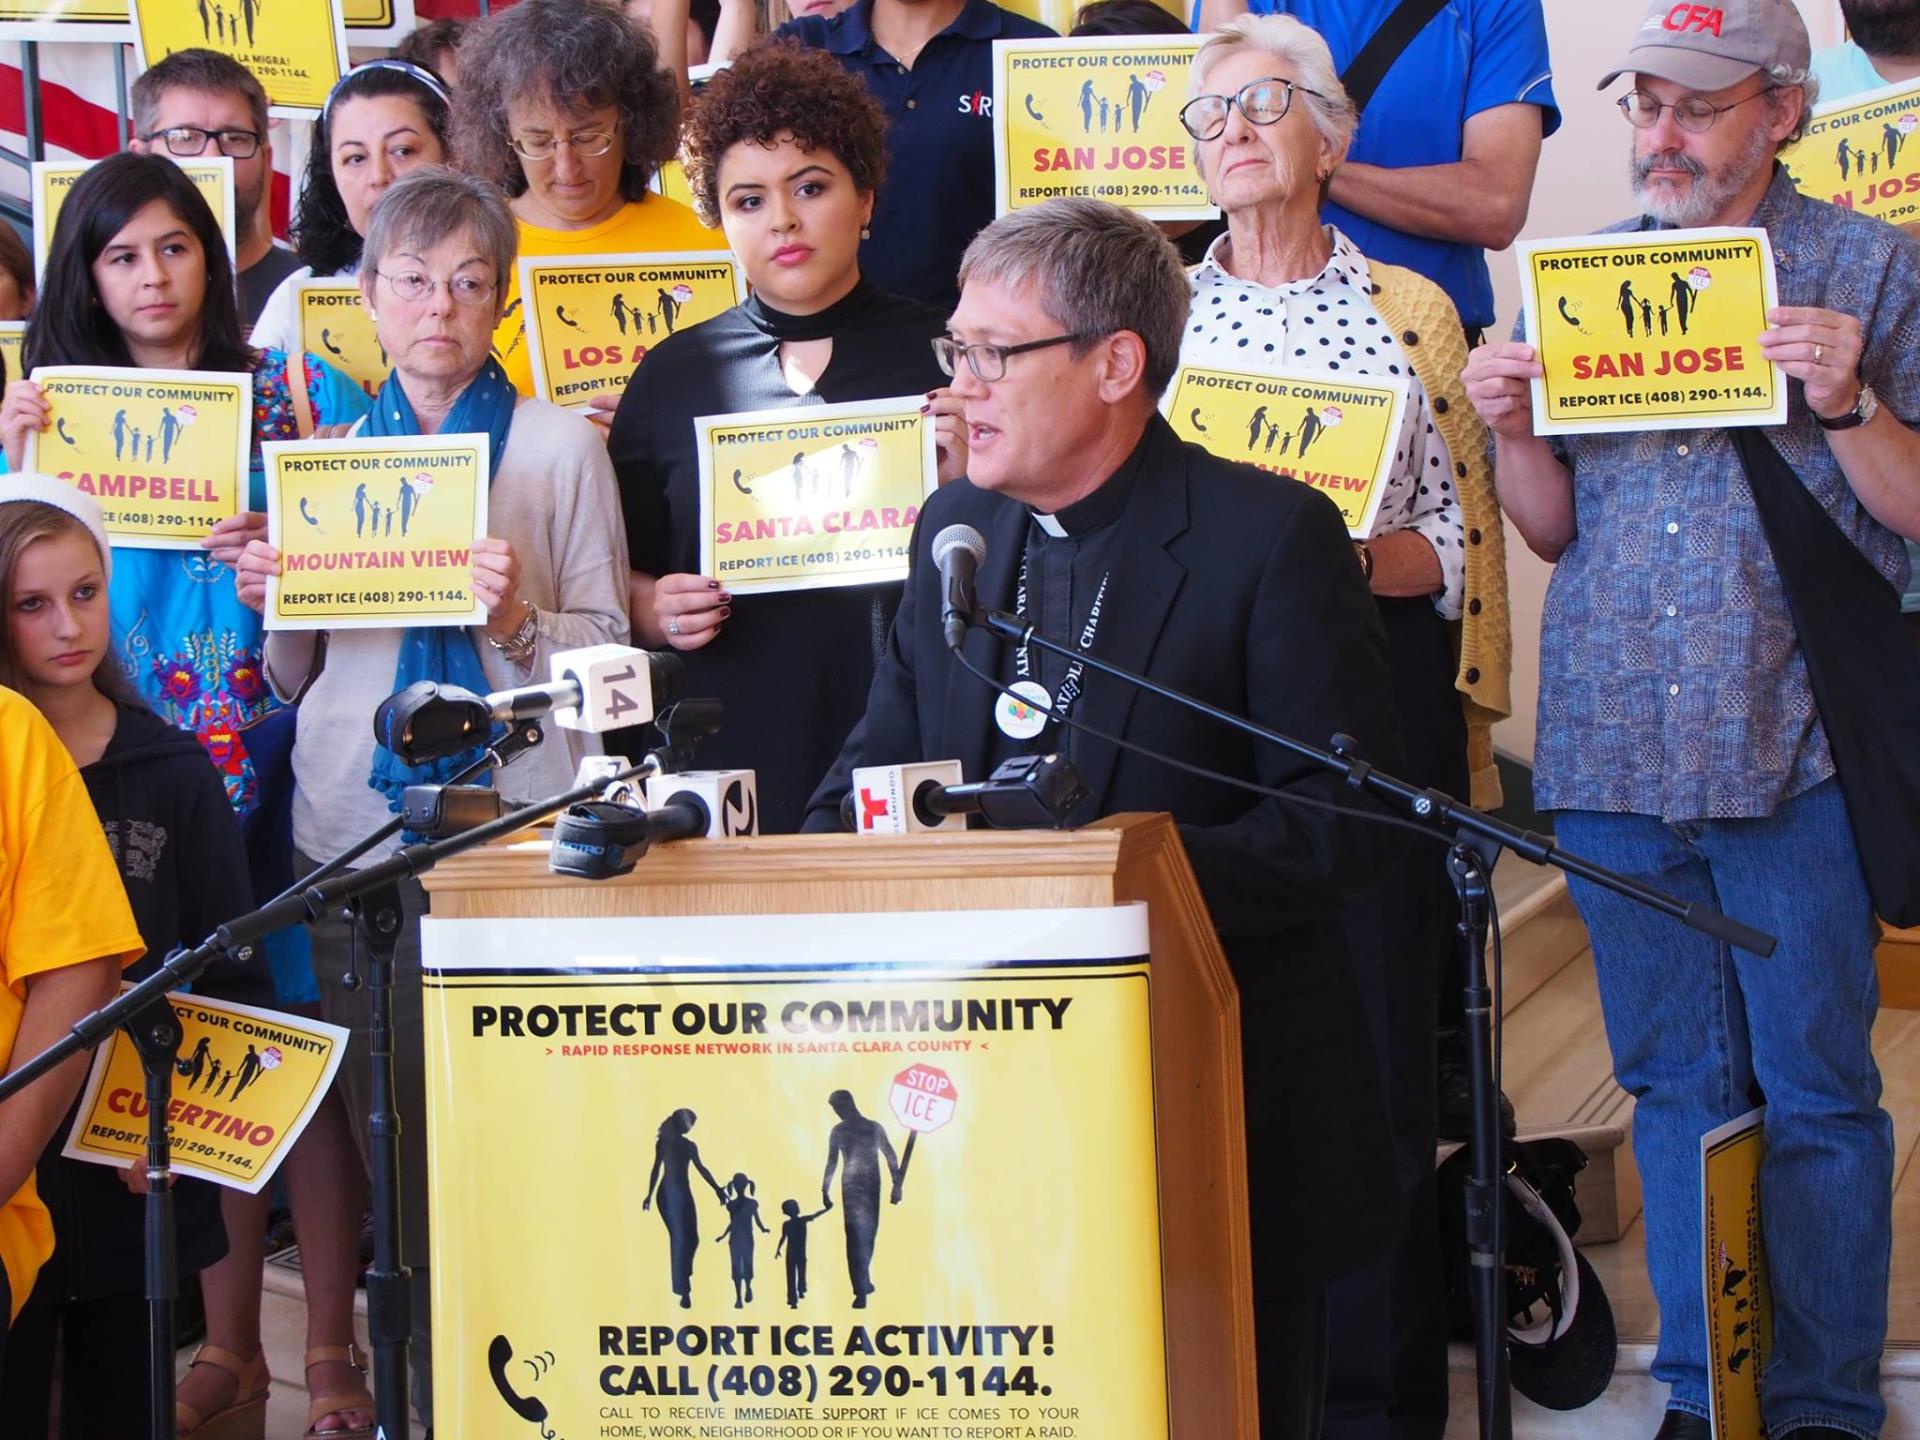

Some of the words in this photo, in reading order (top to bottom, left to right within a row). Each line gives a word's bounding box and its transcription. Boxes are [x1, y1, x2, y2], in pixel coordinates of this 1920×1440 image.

[1662, 4, 1724, 38] CFA
[238, 54, 250, 62] LA
[252, 55, 290, 66] MIGRA!
[258, 66, 310, 78] 290-1144.
[1012, 56, 1074, 70] PROTECT
[1078, 56, 1108, 67] OUR
[1112, 54, 1195, 66] COMMUNIT
[1830, 113, 1860, 130] OUR
[1864, 96, 1920, 121] COMMU
[1034, 147, 1095, 172] SAN
[1103, 146, 1185, 170] JOSE
[1020, 186, 1068, 198] REPORT
[1070, 186, 1089, 196] ICE
[1092, 184, 1128, 198] (408)
[1132, 184, 1203, 196] 290-1144.
[1862, 172, 1920, 205] JOS
[1540, 256, 1608, 270] PROTECT
[1612, 254, 1646, 266] OUR
[1650, 246, 1752, 264] COMMUNITY
[539, 273, 602, 284] PROTECT
[604, 272, 636, 283] OUR
[639, 268, 728, 281] COMMUNITY
[308, 296, 362, 306] PROTEC
[563, 345, 624, 370] LOS
[1572, 352, 1644, 380] SAN
[1654, 346, 1745, 376] JOSE
[47, 382, 108, 396] PROTECT
[112, 386, 142, 398] OUR
[146, 388, 235, 402] COMMUNITY
[556, 378, 606, 396] REPORT
[610, 375, 630, 386] ICE
[1186, 374, 1252, 392] PROTECT
[1255, 383, 1288, 396] OUR
[1292, 386, 1388, 408] COMMUNITY
[1560, 395, 1618, 408] REPORT
[1620, 393, 1642, 404] ICE
[1646, 390, 1685, 406] (408)
[1689, 386, 1767, 401] 290-1144.
[718, 430, 784, 446] PROTECT
[788, 428, 820, 440] OUR
[824, 418, 918, 436] COMMUNITY
[284, 460, 346, 472] PROTECT
[350, 458, 380, 470] OUR
[384, 456, 472, 469] COMMUNITY
[1304, 470, 1368, 492] VIEW
[118, 510, 154, 526] (408)
[716, 516, 814, 544] SANTA
[822, 506, 918, 533] CLARA
[286, 550, 405, 572] MOUNTAIN
[411, 548, 470, 568] VIEW
[719, 556, 772, 571] REPORT
[776, 555, 798, 566] ICE
[802, 551, 840, 566] (408)
[283, 592, 335, 604] REPORT
[336, 592, 356, 604] ICE
[359, 591, 394, 604] (408)
[398, 590, 468, 602] 290-1144.
[601, 664, 639, 720] 14
[472, 1003, 662, 1037] PROTECT
[672, 1002, 769, 1036] OUR
[780, 997, 1074, 1034] COMMUNITY
[196, 1012, 230, 1030] OUR
[233, 1020, 327, 1056] COMMUNITY
[562, 1044, 609, 1056] RAPID
[612, 1044, 691, 1056] RESPONSE
[695, 1042, 772, 1055] NETWORK
[777, 1042, 793, 1054] IN
[797, 1042, 848, 1054] SANTA
[852, 1040, 904, 1053] CLARA
[908, 1040, 972, 1052] COUNTY
[906, 1069, 949, 1094] STOP
[108, 1087, 274, 1148] CUERTINO
[904, 1092, 938, 1122] ICE
[90, 1124, 144, 1145] REPORT
[186, 1140, 253, 1170] 290-1144.
[1708, 1194, 1717, 1304] COMUNIDAD
[599, 1324, 760, 1356] REPORT
[770, 1324, 834, 1356] ICE
[843, 1324, 1055, 1356] ACTIVITY!
[600, 1364, 699, 1396] CALL
[707, 1364, 818, 1403] (408)
[829, 1364, 1053, 1397] 290-1144.
[600, 1407, 632, 1418] CALL
[641, 1407, 660, 1418] TO
[670, 1407, 725, 1418] RECEIVE
[735, 1407, 813, 1418] IMMEDIATE
[823, 1407, 887, 1418] SUPPORT
[896, 1407, 907, 1418] IF
[917, 1407, 938, 1418] ICE
[948, 1407, 1000, 1418] COMES
[1010, 1407, 1030, 1418] TO
[1038, 1407, 1079, 1418] YOUR
[600, 1426, 646, 1438] HOME,
[650, 1426, 696, 1438] WORK,
[700, 1426, 818, 1438] NEIGHBORHOOD
[822, 1426, 842, 1438] OR
[846, 1426, 858, 1438] IF
[861, 1426, 892, 1438] YOU
[896, 1426, 938, 1438] WANT
[942, 1426, 962, 1438] TO
[966, 1426, 1020, 1438] REPORT
[1025, 1426, 1036, 1438] A
[1040, 1426, 1077, 1438] RAID.
